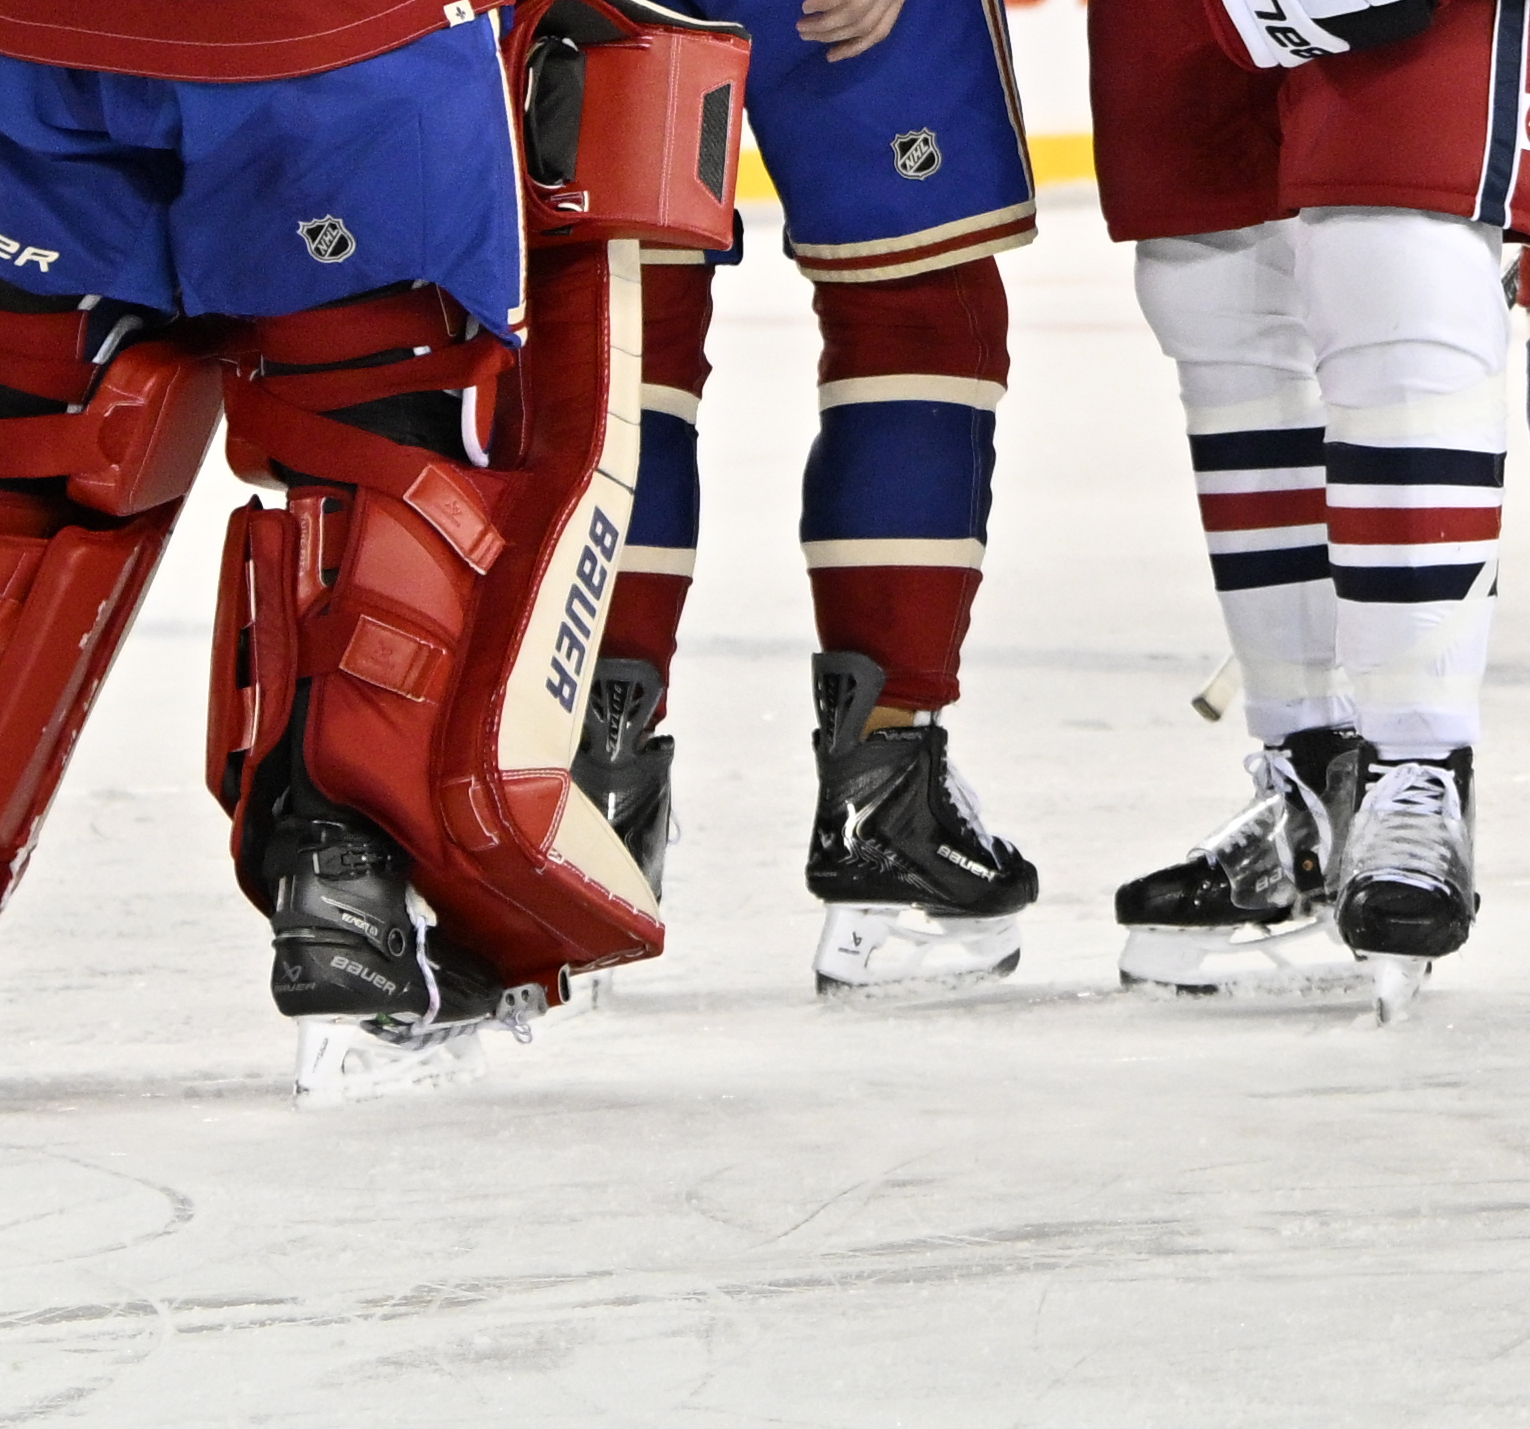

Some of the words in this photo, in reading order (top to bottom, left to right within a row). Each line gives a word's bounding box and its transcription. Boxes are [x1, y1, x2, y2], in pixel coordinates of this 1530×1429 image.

[896, 140, 932, 173] NHL
[317, 223, 353, 259] NHL
[543, 504, 620, 716] BAUER
[935, 843, 998, 884] BAUER
[330, 955, 397, 997] BAUER
